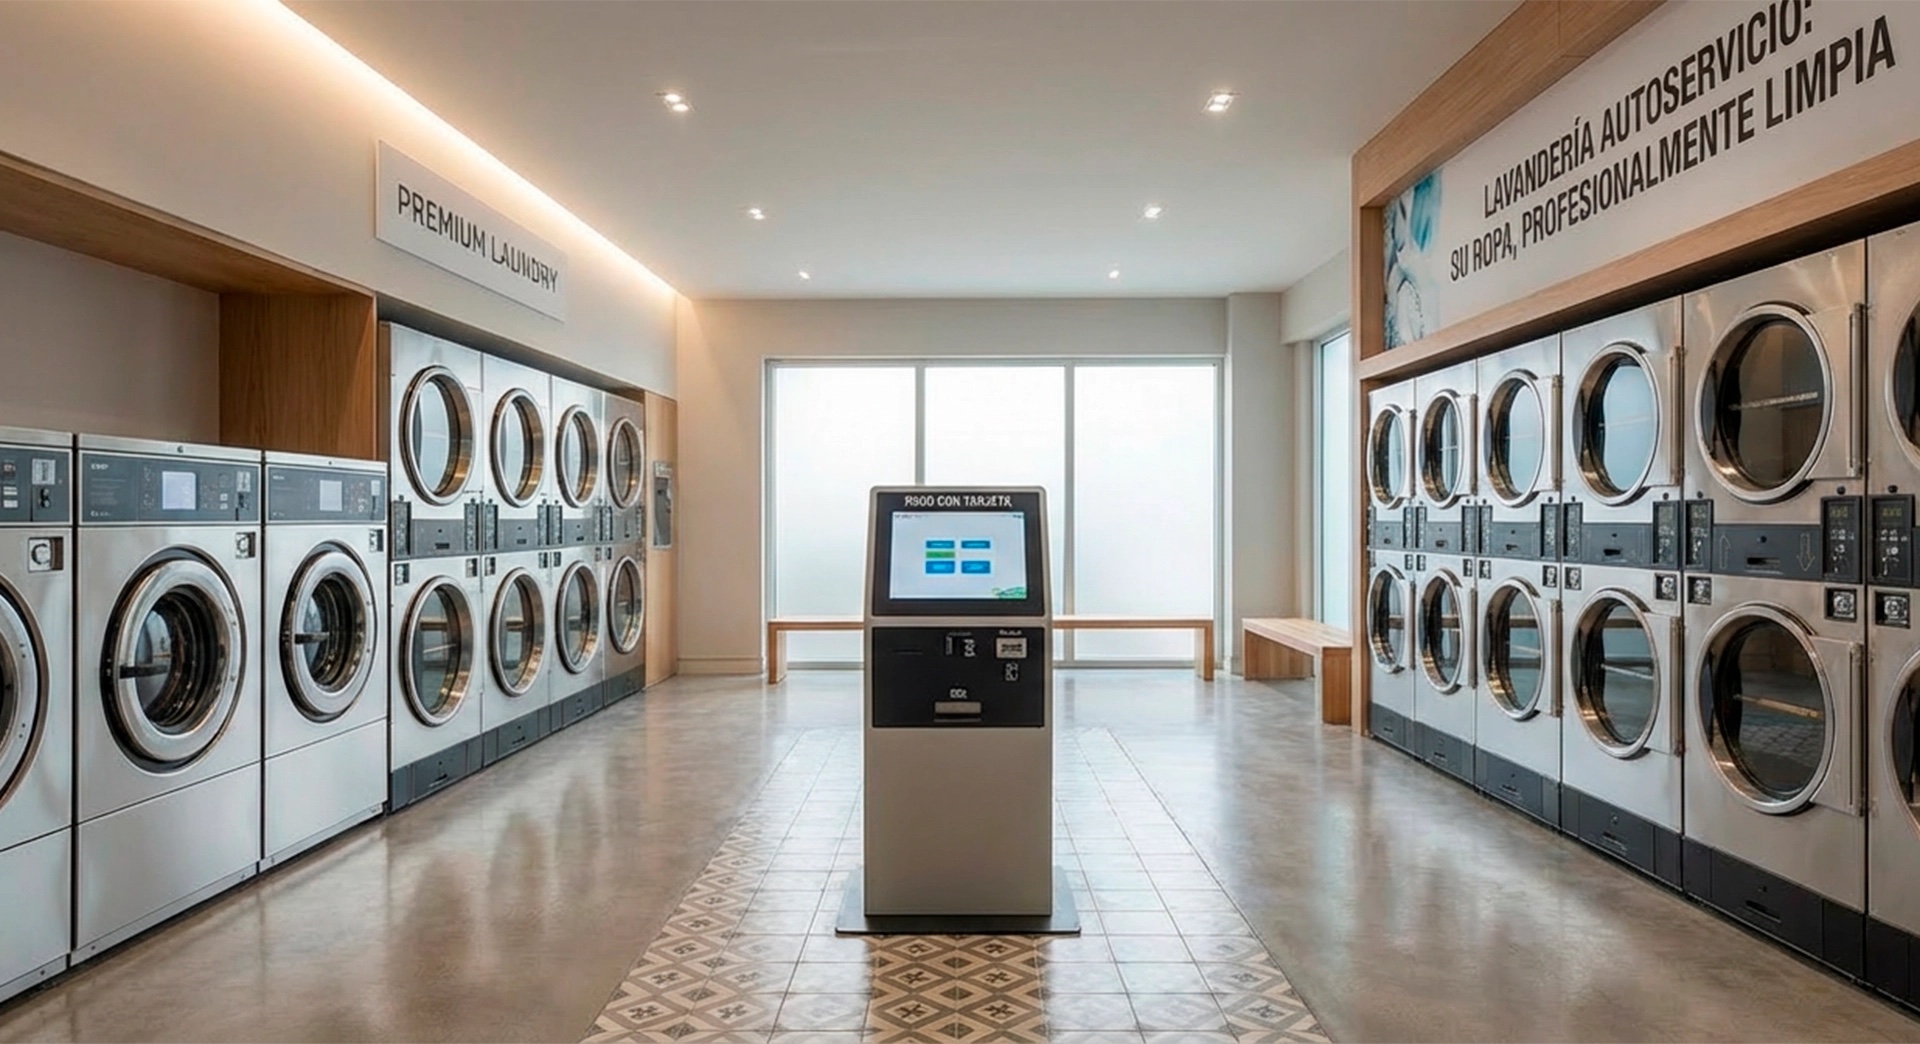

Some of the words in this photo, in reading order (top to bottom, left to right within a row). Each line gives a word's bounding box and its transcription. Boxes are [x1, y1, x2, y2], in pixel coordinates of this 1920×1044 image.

[1450, 244, 1469, 281] SU
[1473, 222, 1517, 272] ROPA,
[1522, 89, 1755, 249] PROFESIONALMENTE
[1766, 15, 1896, 129] LIMPIA
[1484, 116, 1595, 219] LAVANDERÍA
[398, 183, 486, 258] PREMIUM
[491, 235, 559, 293] LAUNDRY
[937, 495, 961, 507] CON
